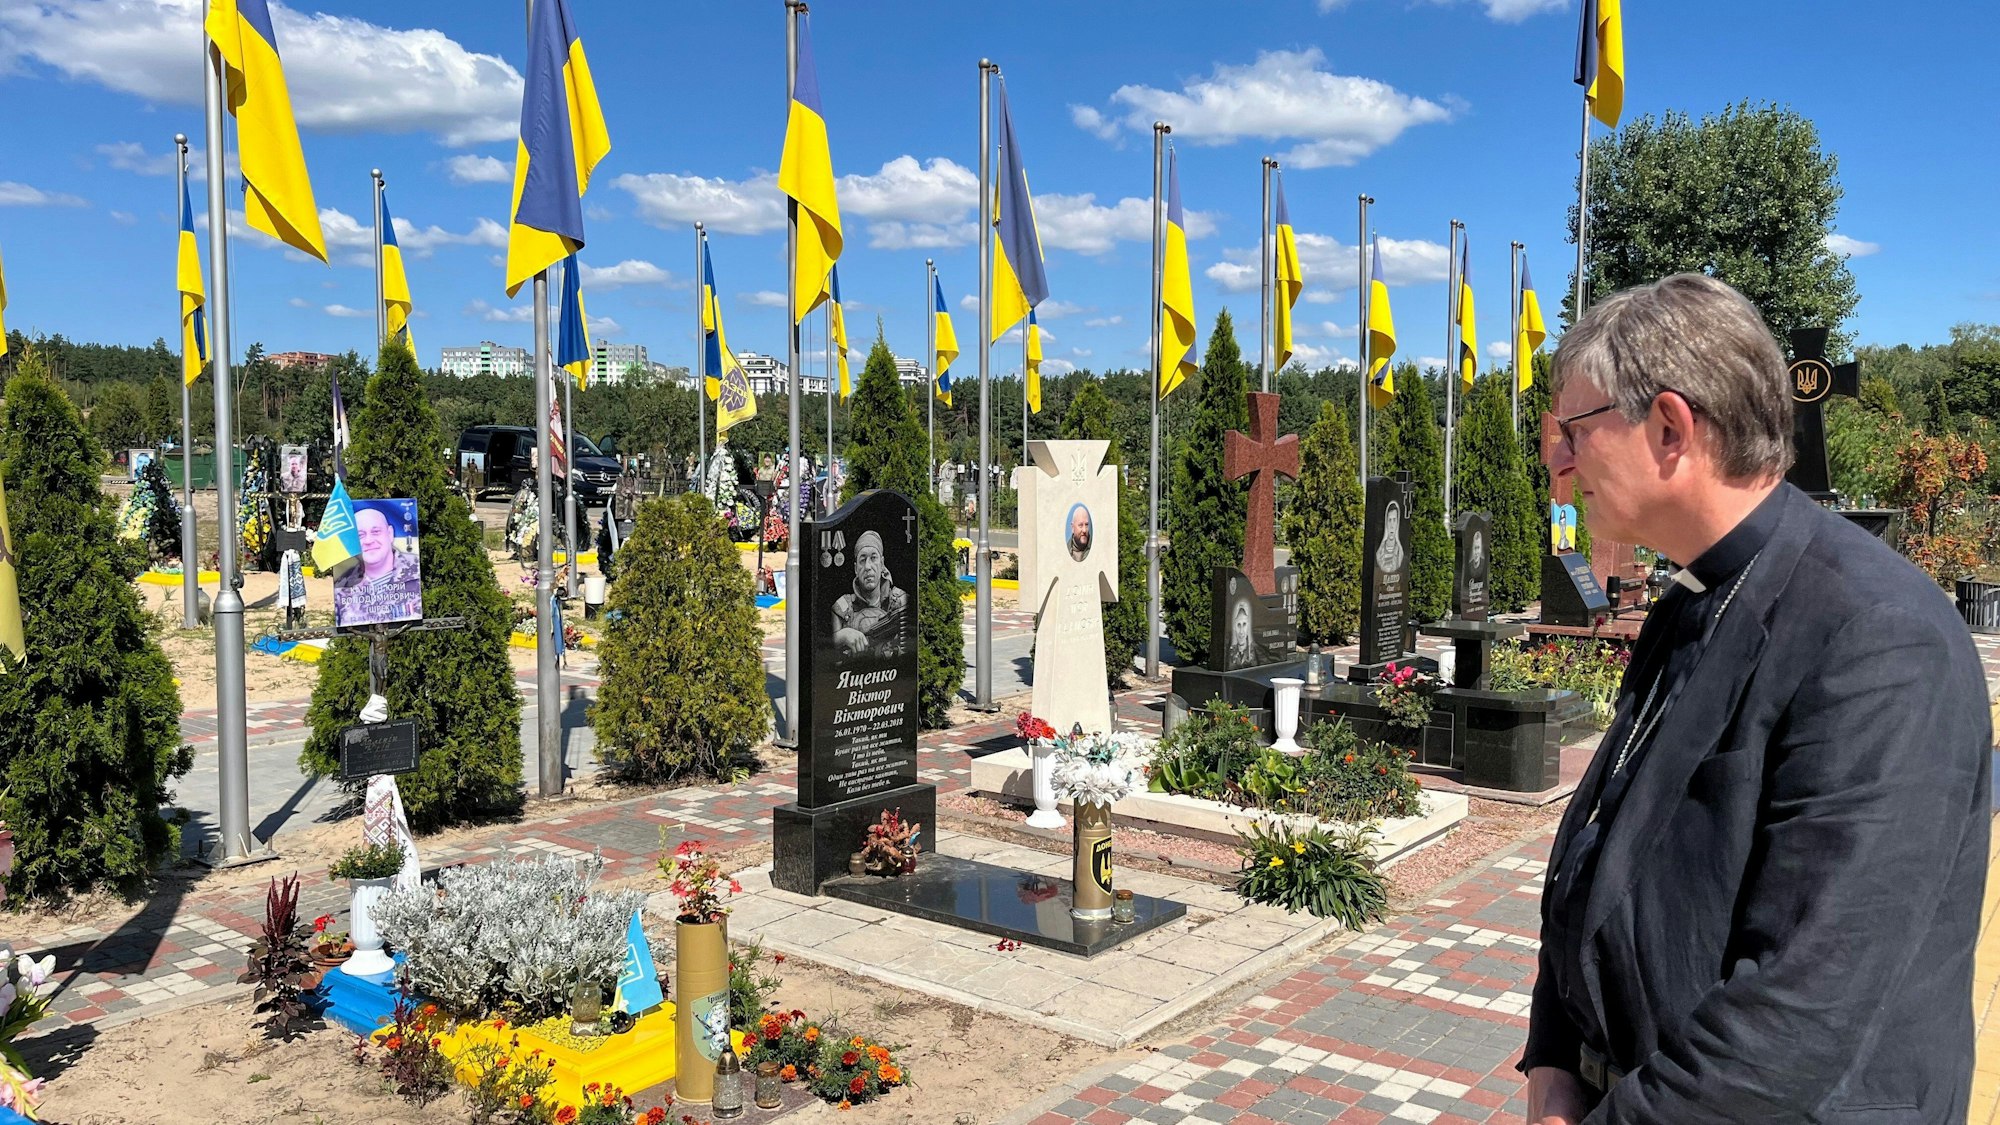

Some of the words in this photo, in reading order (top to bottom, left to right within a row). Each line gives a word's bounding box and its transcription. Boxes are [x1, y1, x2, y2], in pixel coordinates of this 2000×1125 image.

[341, 592, 415, 605] ВОЛОДИМИРОВИЧ
[836, 668, 898, 690] Ященко
[847, 689, 892, 706] Віктор
[832, 702, 905, 725] Вікторович
[834, 724, 867, 738] 26.01.1970
[872, 717, 904, 731] 22.03.2018
